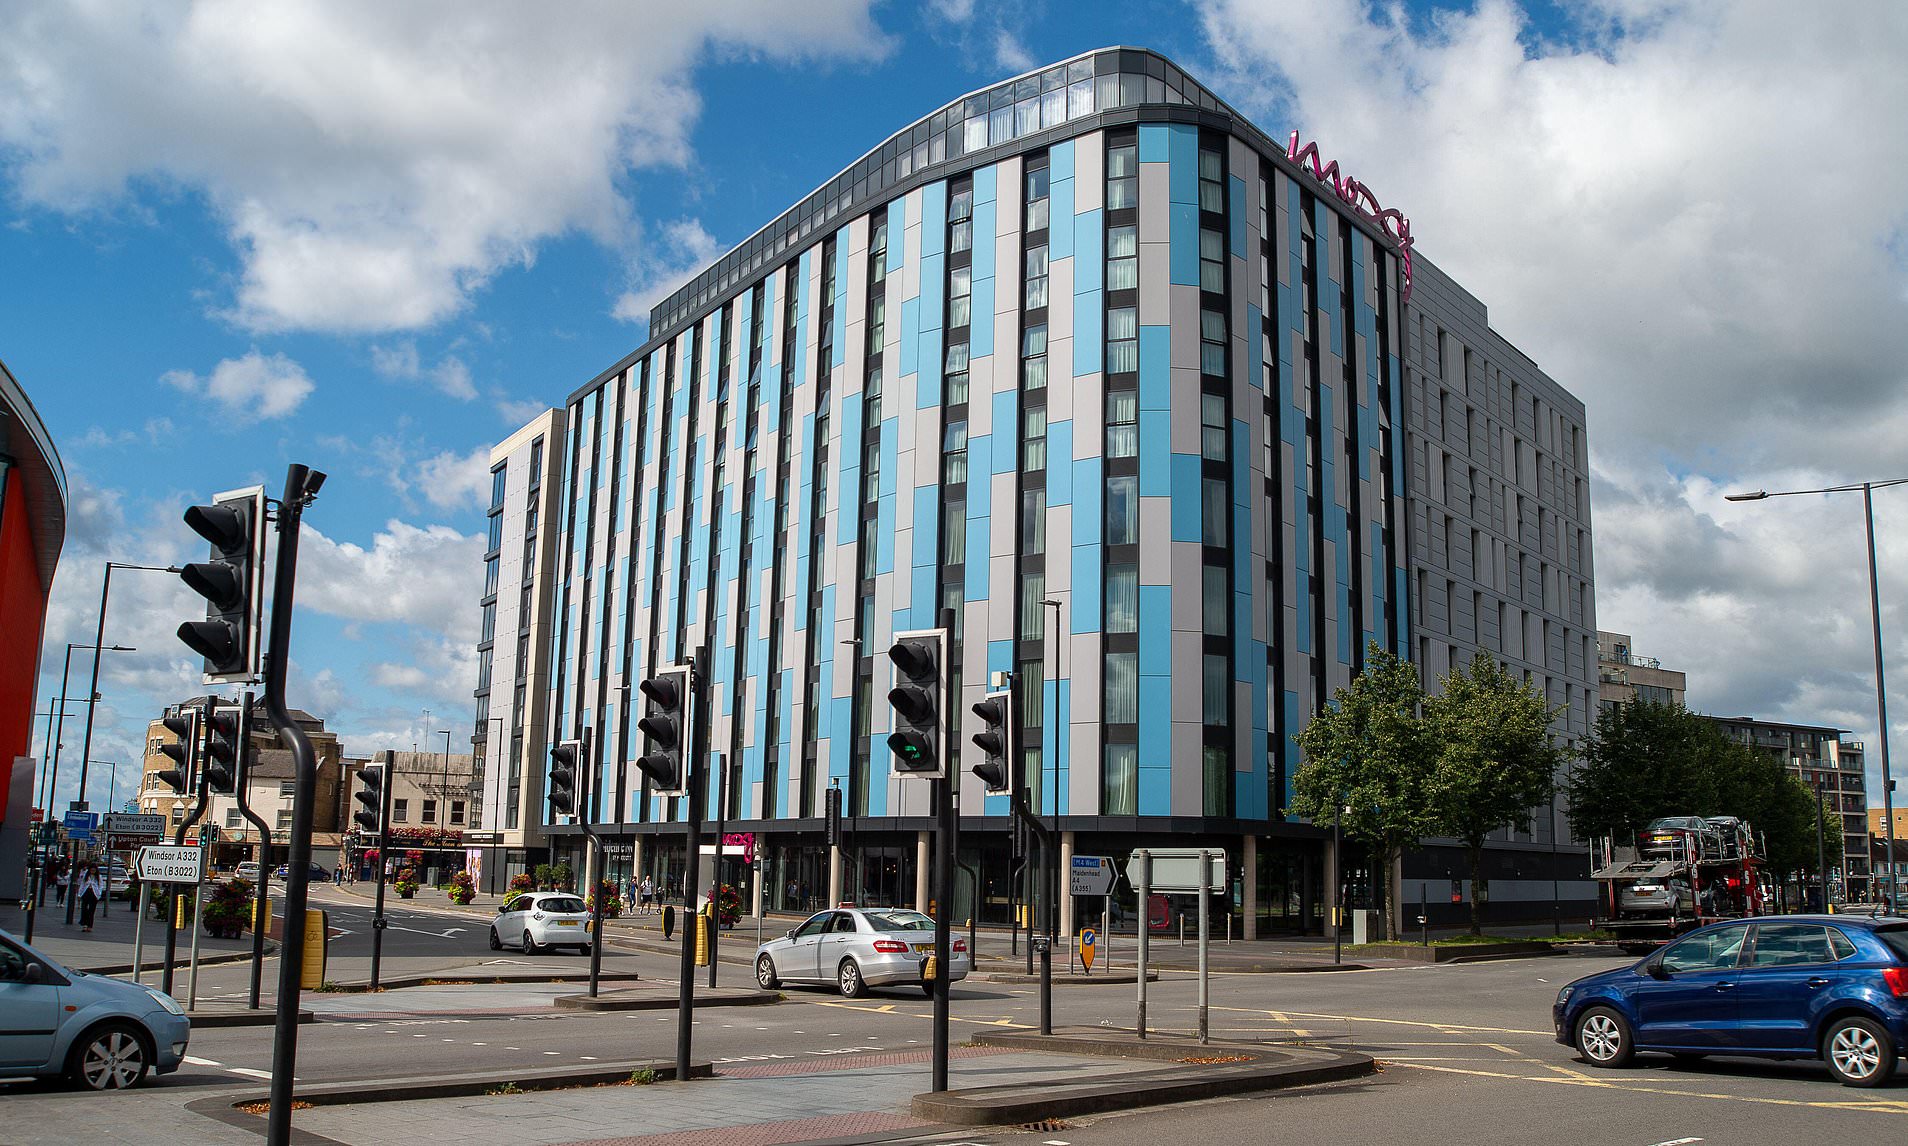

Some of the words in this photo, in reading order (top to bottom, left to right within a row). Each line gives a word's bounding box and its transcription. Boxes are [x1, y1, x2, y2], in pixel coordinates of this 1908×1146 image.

[115, 815, 142, 823] Windsor
[148, 850, 175, 861] Windsor
[176, 851, 198, 862] A332
[147, 865, 163, 876] Eton
[164, 865, 198, 878] (B3022)
